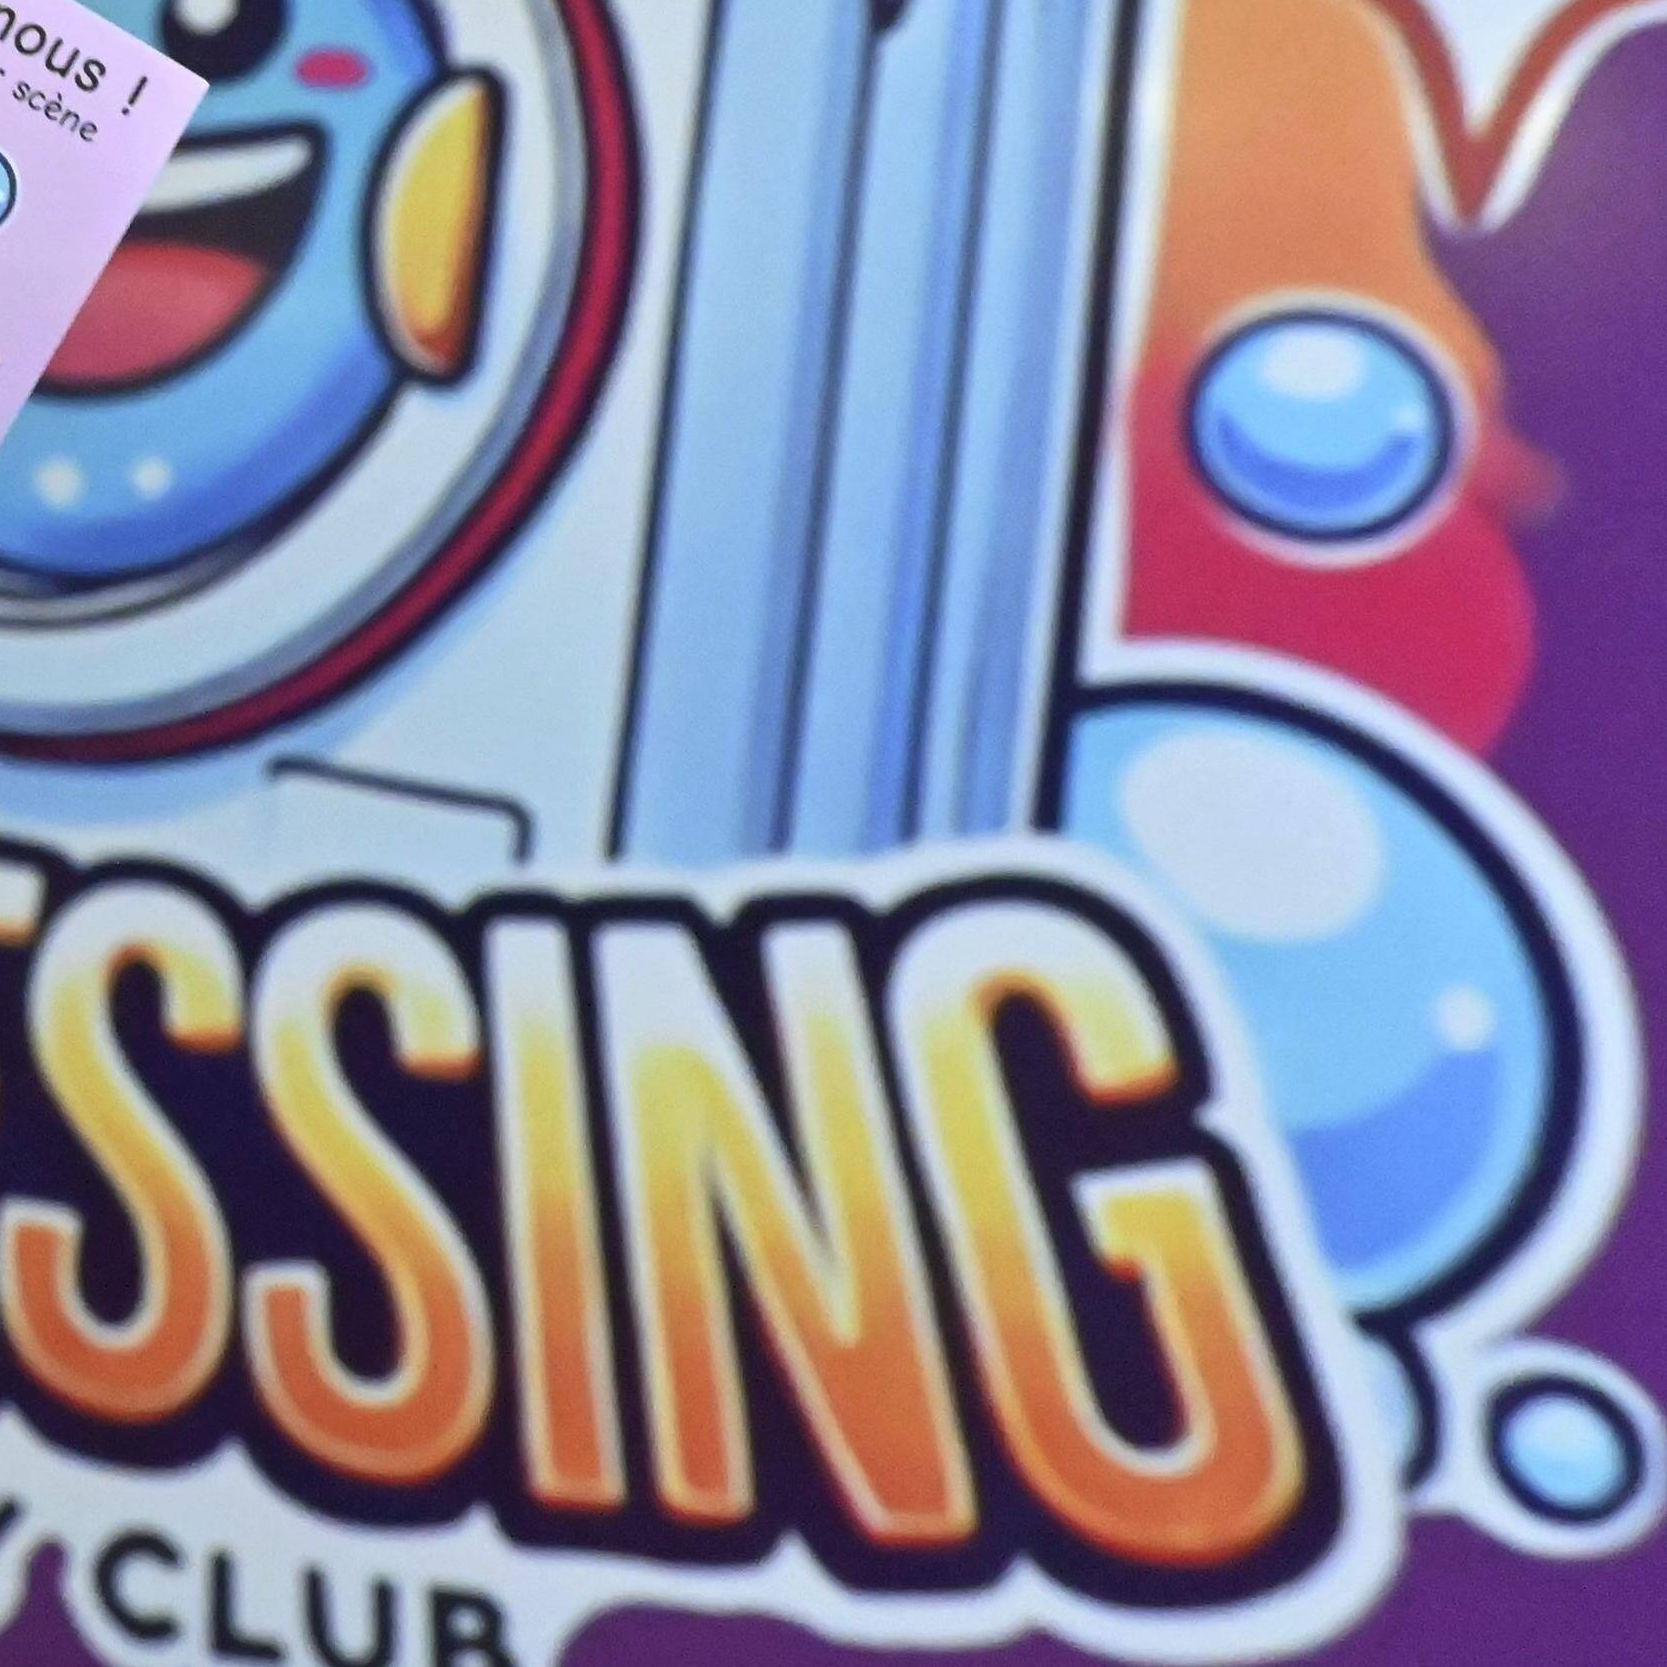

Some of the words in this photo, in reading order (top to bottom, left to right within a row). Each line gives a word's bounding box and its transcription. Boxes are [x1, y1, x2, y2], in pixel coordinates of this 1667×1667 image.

[12, 74, 100, 144] scène
[120, 74, 150, 117] !
[93, 1528, 522, 1667] CLUB
